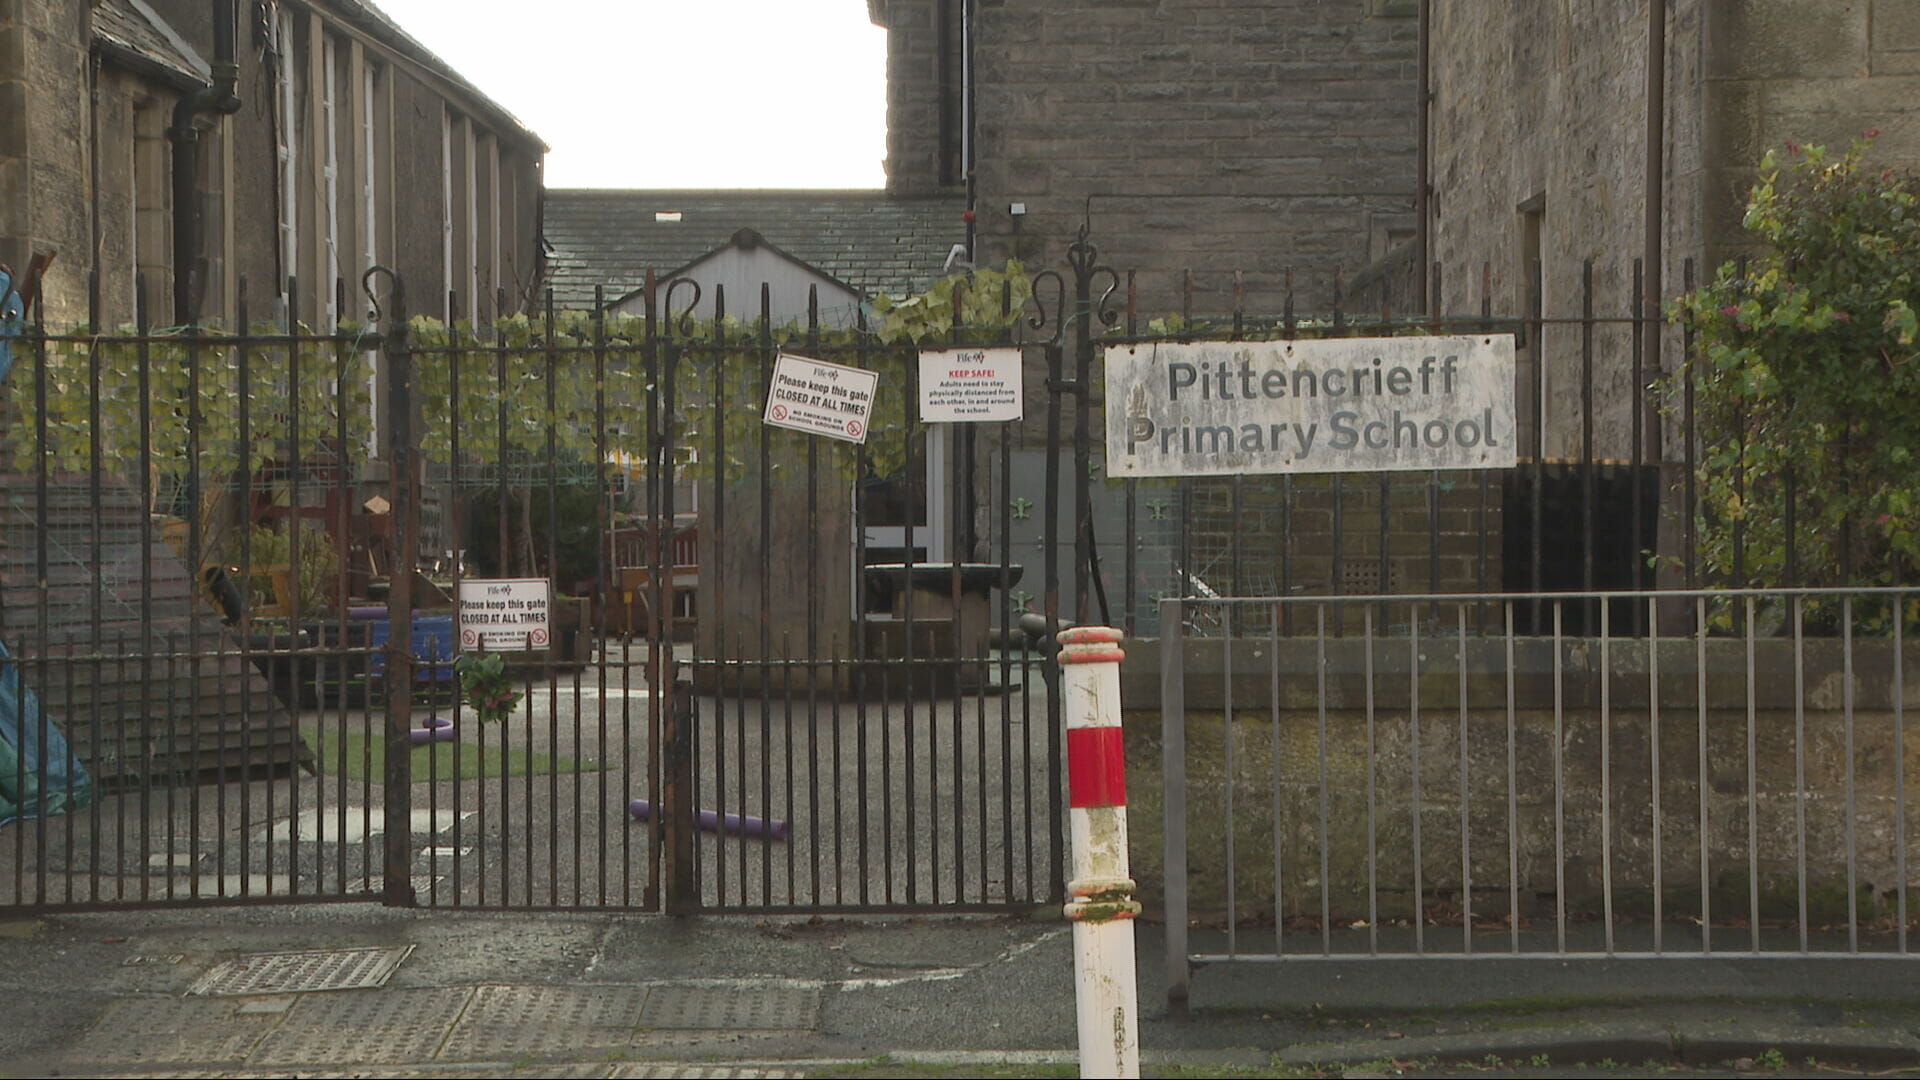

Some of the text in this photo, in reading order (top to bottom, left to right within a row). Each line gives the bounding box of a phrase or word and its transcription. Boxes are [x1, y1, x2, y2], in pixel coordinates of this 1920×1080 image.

[957, 353, 972, 363] Fife
[949, 369, 995, 378] KEEP SAFE!
[1168, 355, 1458, 401] Pittencrieff
[778, 374, 869, 402] Please keep this gate
[929, 389, 962, 397] physically
[776, 388, 866, 416] CLOSED AT ALL TIMES
[803, 411, 833, 421] SMOKING
[788, 416, 844, 431] SCHOOL GROUNDS
[1126, 407, 1498, 460] Primary School
[460, 599, 546, 611] Please keep this gate
[461, 612, 546, 624] CLOSED AT ALL TIMES
